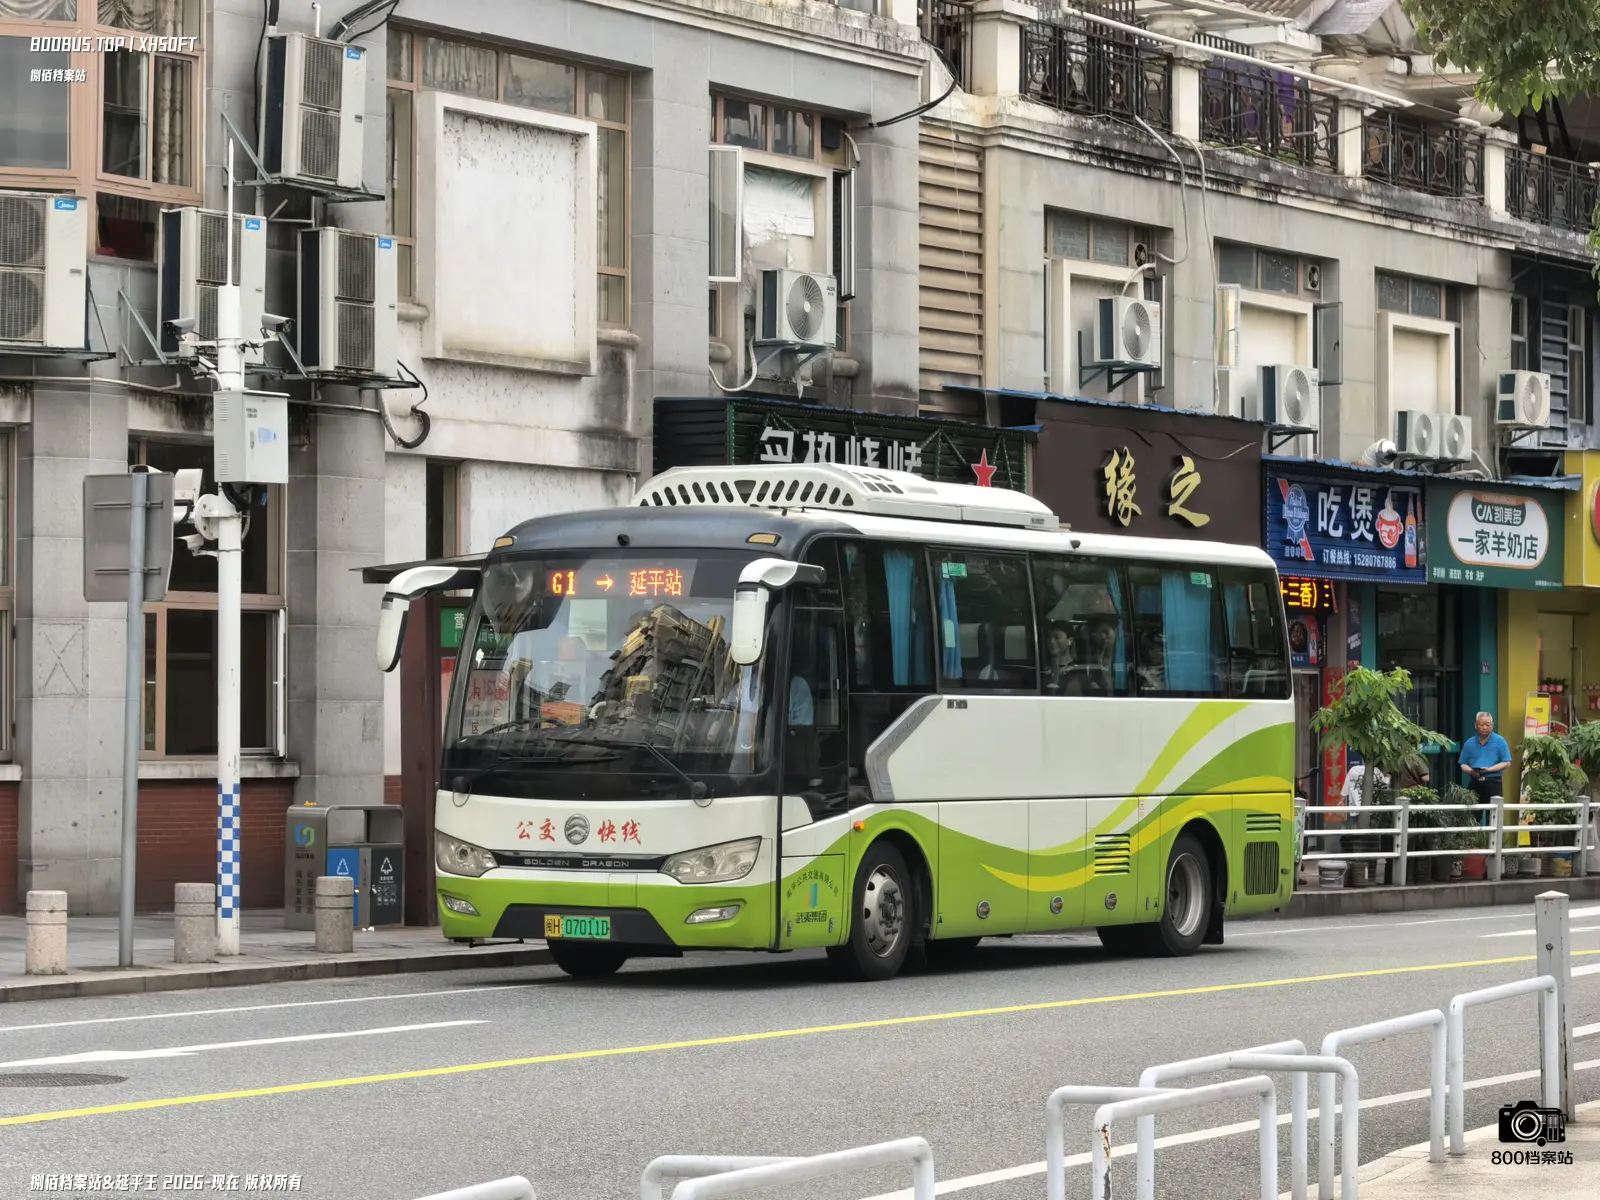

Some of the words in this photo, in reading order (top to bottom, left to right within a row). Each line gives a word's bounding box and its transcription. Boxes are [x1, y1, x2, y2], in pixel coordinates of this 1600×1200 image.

[1317, 486, 1374, 542] 吃煲
[1494, 505, 1522, 525] 凯美多
[1458, 529, 1538, 561] 一家羊奶店
[552, 571, 576, 595] G1
[629, 568, 683, 596] 延平站
[516, 817, 555, 842] 公交
[597, 819, 641, 846] 快线
[523, 858, 570, 867] GOLDEN
[582, 860, 630, 868] DRAGON
[796, 910, 827, 924] 武夷集团
